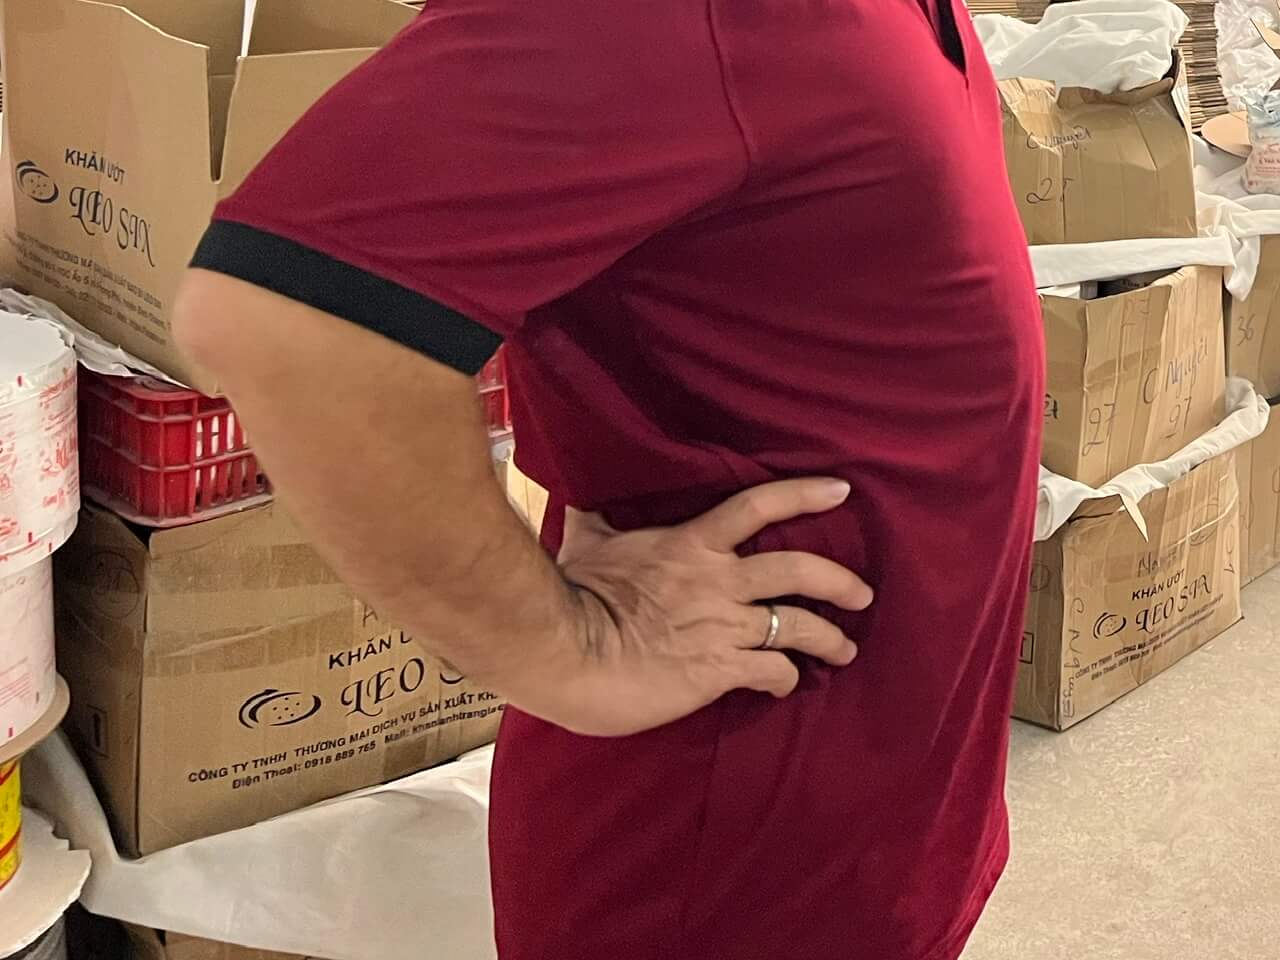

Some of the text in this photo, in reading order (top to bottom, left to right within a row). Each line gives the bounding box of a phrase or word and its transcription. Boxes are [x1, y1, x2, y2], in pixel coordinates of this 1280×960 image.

[69, 186, 114, 236] LEO
[328, 634, 392, 670] KHĂN
[340, 657, 425, 718] LEO
[187, 766, 229, 784] CÔNG
[231, 761, 249, 774] TY
[252, 751, 288, 770] TNHH
[294, 737, 346, 759] THƯƠNG
[373, 718, 398, 735] DỊCH
